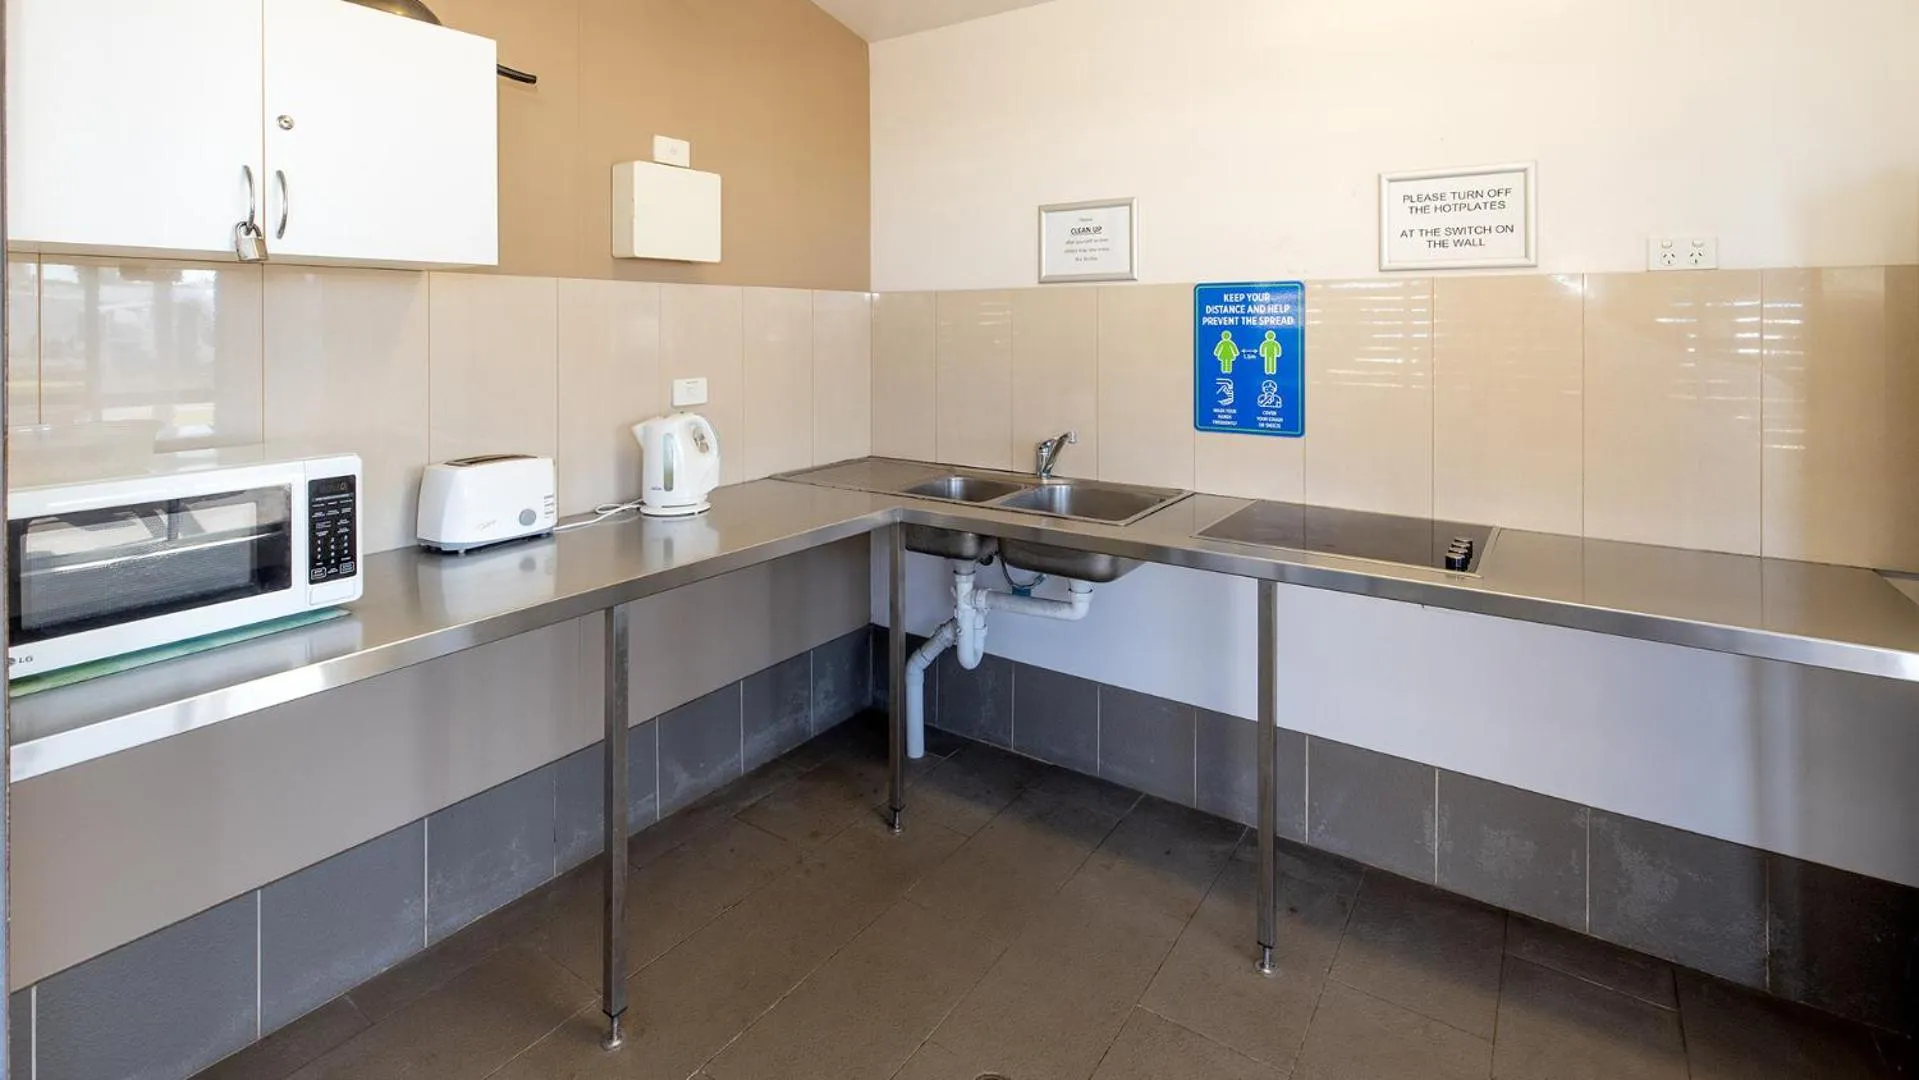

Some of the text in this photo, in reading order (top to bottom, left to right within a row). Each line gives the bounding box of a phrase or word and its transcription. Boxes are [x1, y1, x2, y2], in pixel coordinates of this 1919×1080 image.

[1402, 188, 1512, 204] PLEASE TURN OFF
[1408, 200, 1506, 215] THE HOTPLATES
[1070, 225, 1103, 235] CLEAN UP
[1400, 224, 1514, 238] AT THE SWITCH ON
[1426, 238, 1486, 249] THE WALL
[1223, 292, 1271, 303] KEEP YOUR
[1205, 304, 1290, 314] DISTANCE AND HELP
[1202, 315, 1294, 326] PREVENT THE SPREAD
